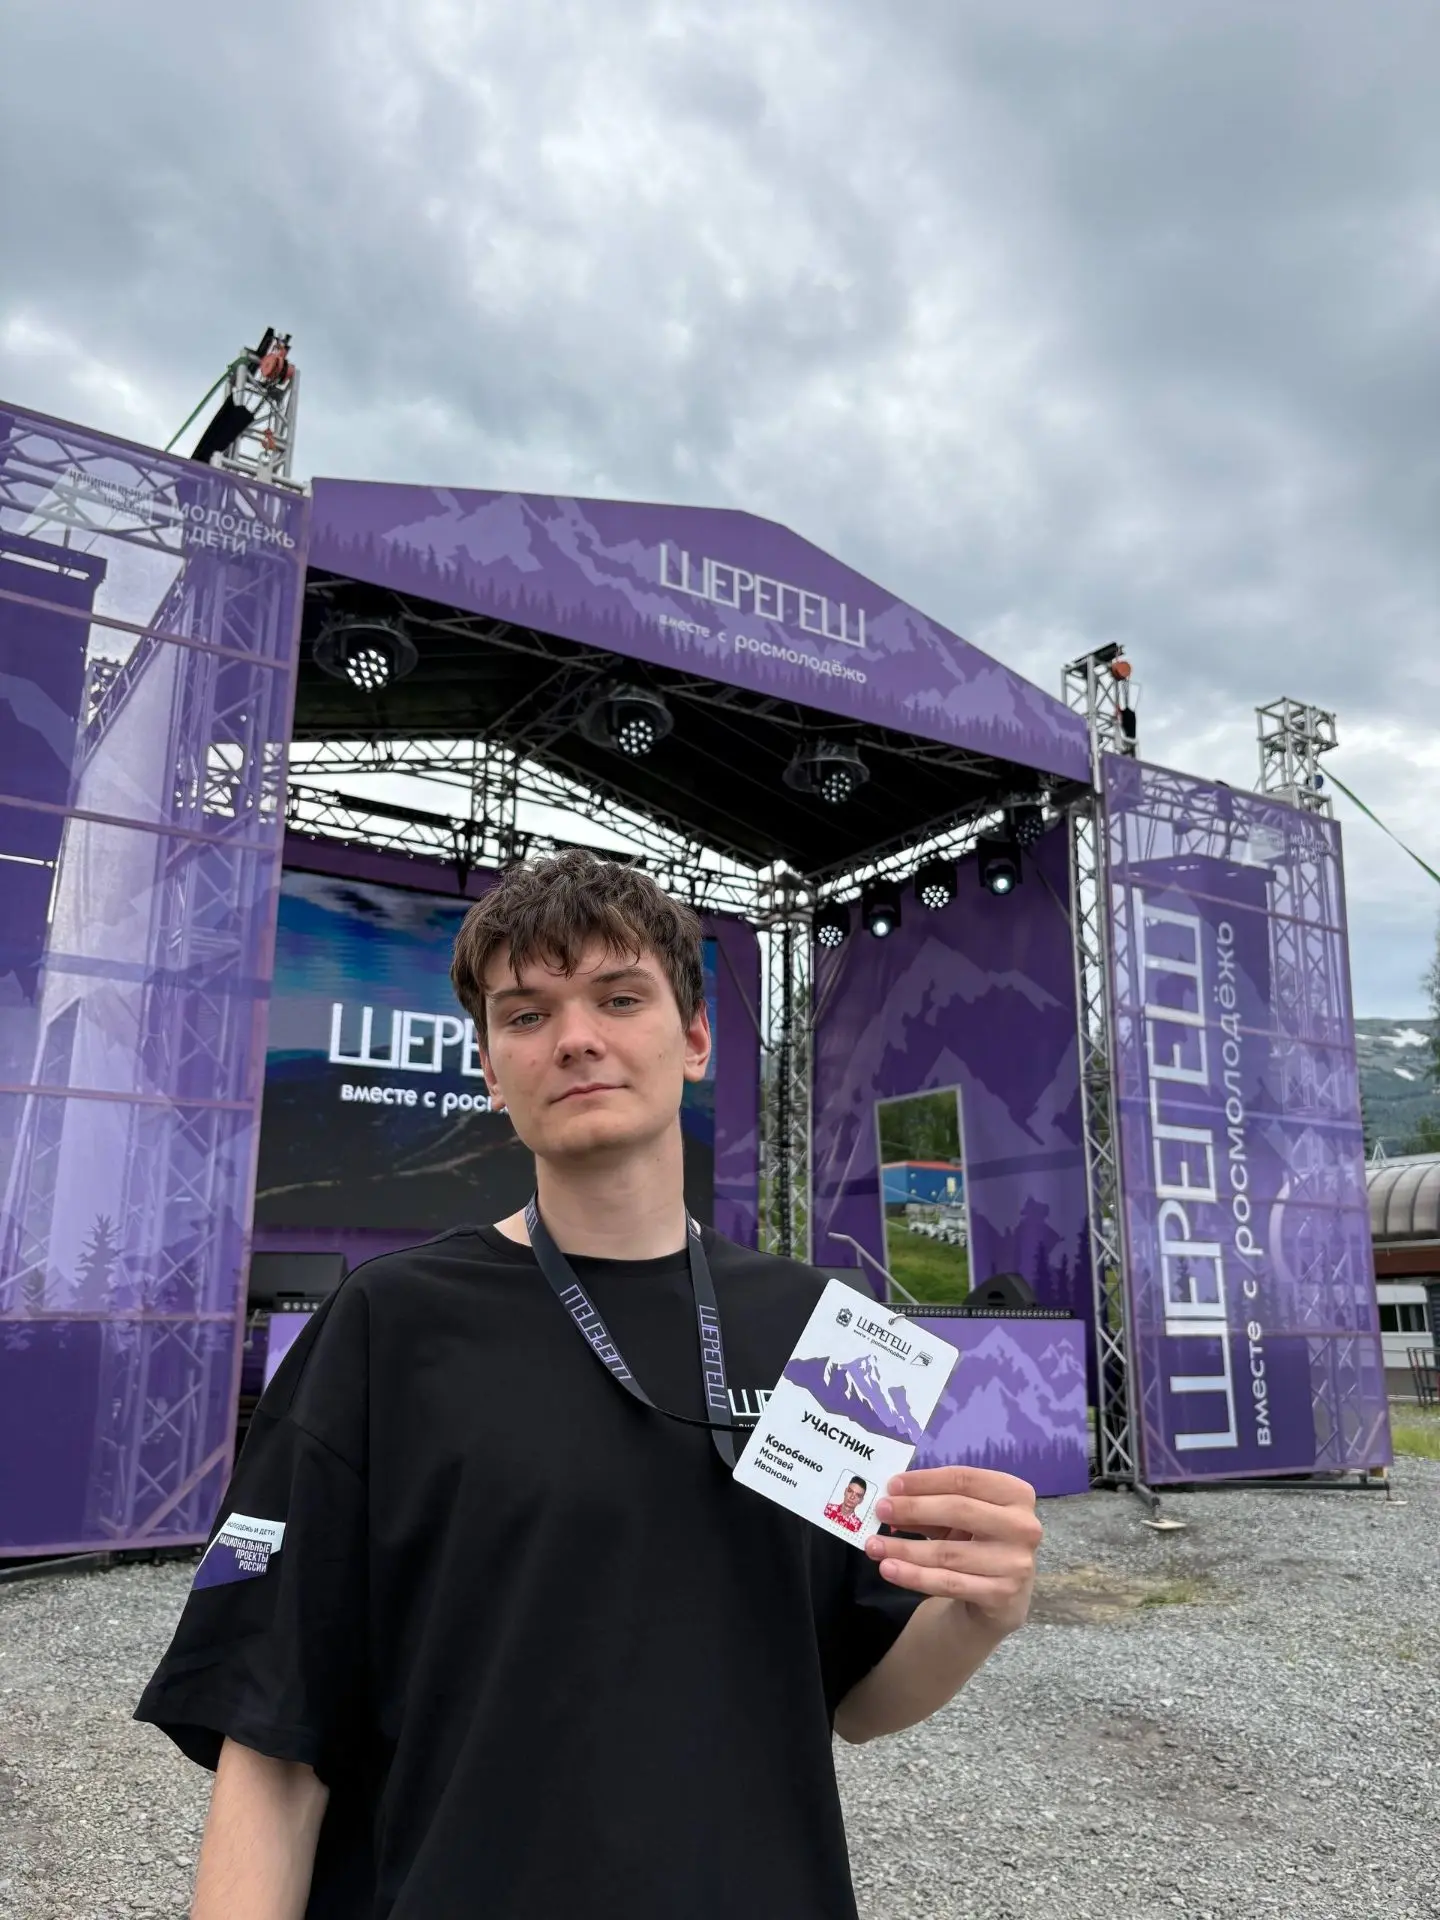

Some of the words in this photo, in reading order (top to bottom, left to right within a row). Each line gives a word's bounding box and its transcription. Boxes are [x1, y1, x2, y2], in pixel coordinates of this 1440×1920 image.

[188, 525, 246, 556] ДЕТИ
[659, 543, 866, 648] ШЕРЕГЕШ
[658, 613, 711, 638] вместе
[717, 631, 727, 643] с
[734, 633, 868, 684] росмолодёжь
[340, 1083, 418, 1107] вместе
[423, 1092, 436, 1108] с
[440, 1091, 508, 1117] рос
[1214, 920, 1264, 1257] росмолодёжь
[1142, 902, 1239, 1451] ШЕРЕГЕШ
[1243, 1279, 1258, 1298] с
[560, 1284, 632, 1379] ШЕРЕГЕШ
[856, 1316, 912, 1355] ШЕРЕГЕШ
[698, 1304, 728, 1409] ШЕРЕГЕШ
[1246, 1320, 1272, 1447] вместе
[765, 1433, 823, 1473] Коробенко
[801, 1410, 875, 1461] УЧАСТНИК
[753, 1457, 798, 1488] Иванович
[759, 1446, 794, 1472] Матвей
[218, 1534, 271, 1553] НАЦИОНАЛЬНЫЕ
[235, 1548, 269, 1563] ПРОЕКТЫ
[238, 1560, 267, 1573] РОССИИ
